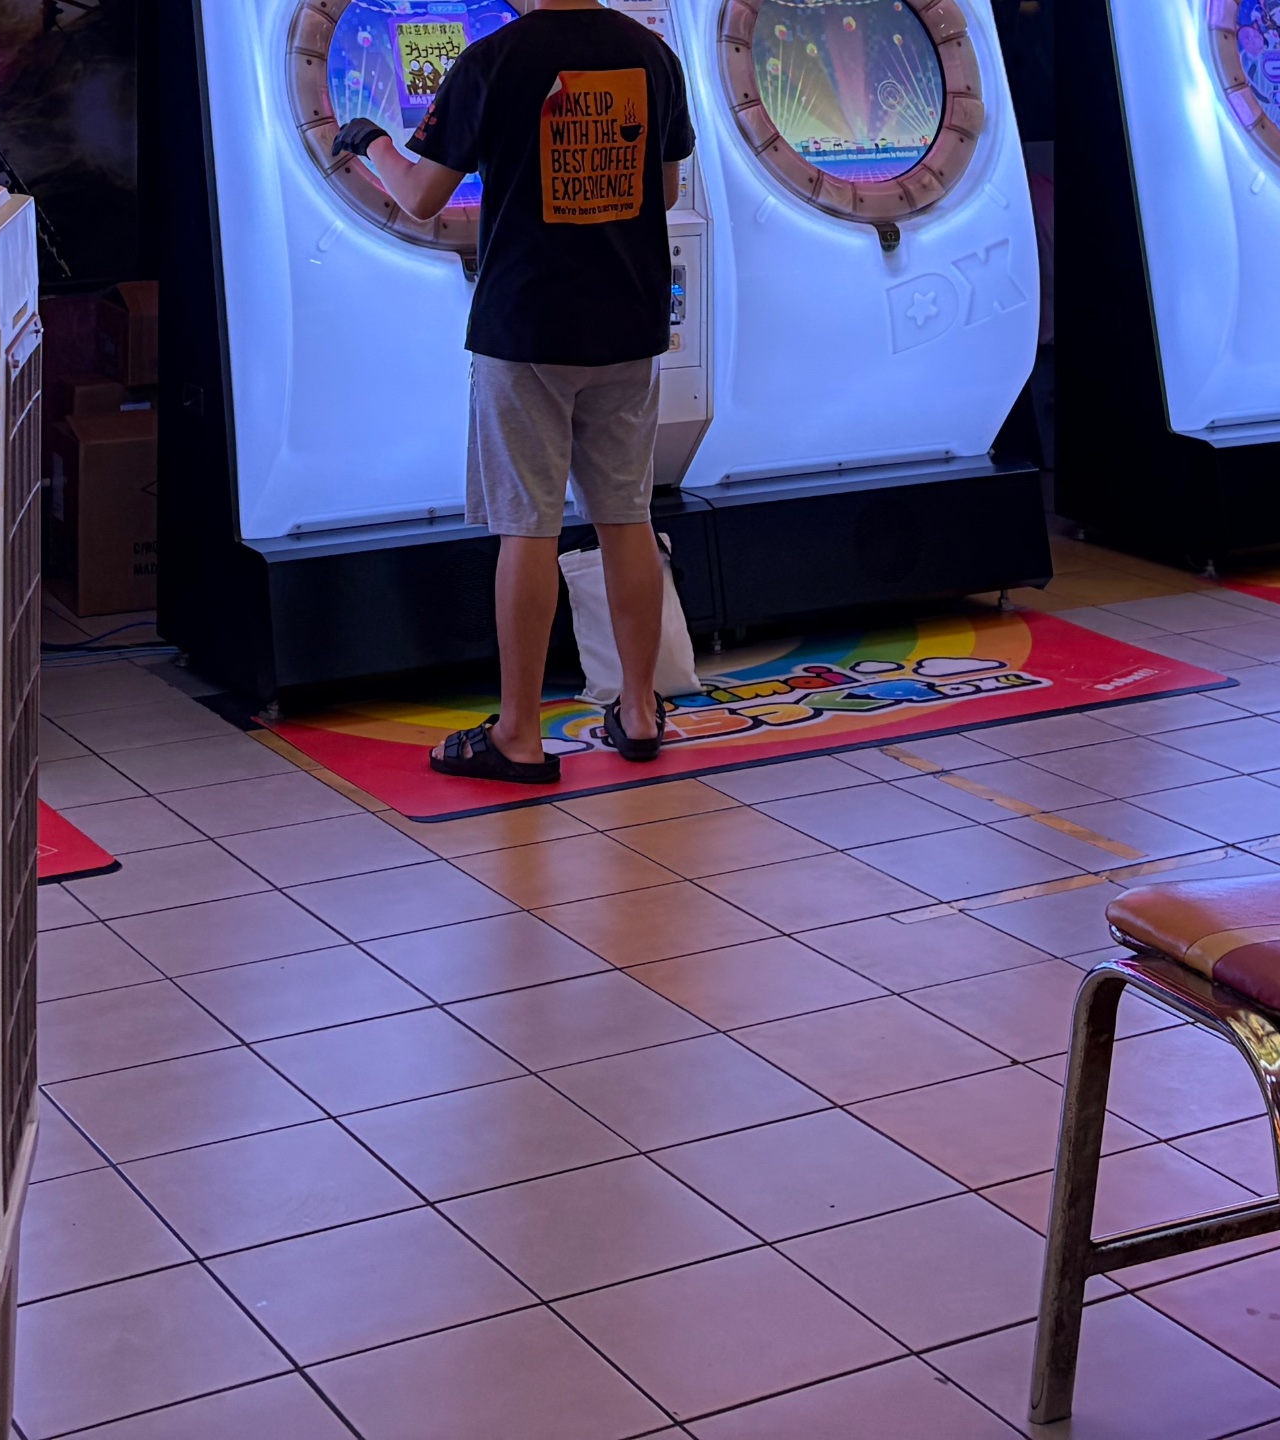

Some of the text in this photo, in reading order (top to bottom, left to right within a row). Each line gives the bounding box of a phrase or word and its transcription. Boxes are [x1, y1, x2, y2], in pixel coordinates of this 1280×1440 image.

[551, 91, 614, 118] WAKE UP
[550, 118, 618, 145] WITH THE
[551, 145, 638, 174] BEST COFFEE
[552, 172, 634, 201] EXPERIENCE
[553, 205, 576, 216] We're
[579, 205, 596, 216] here
[620, 202, 634, 212] you
[886, 238, 1028, 355] DX
